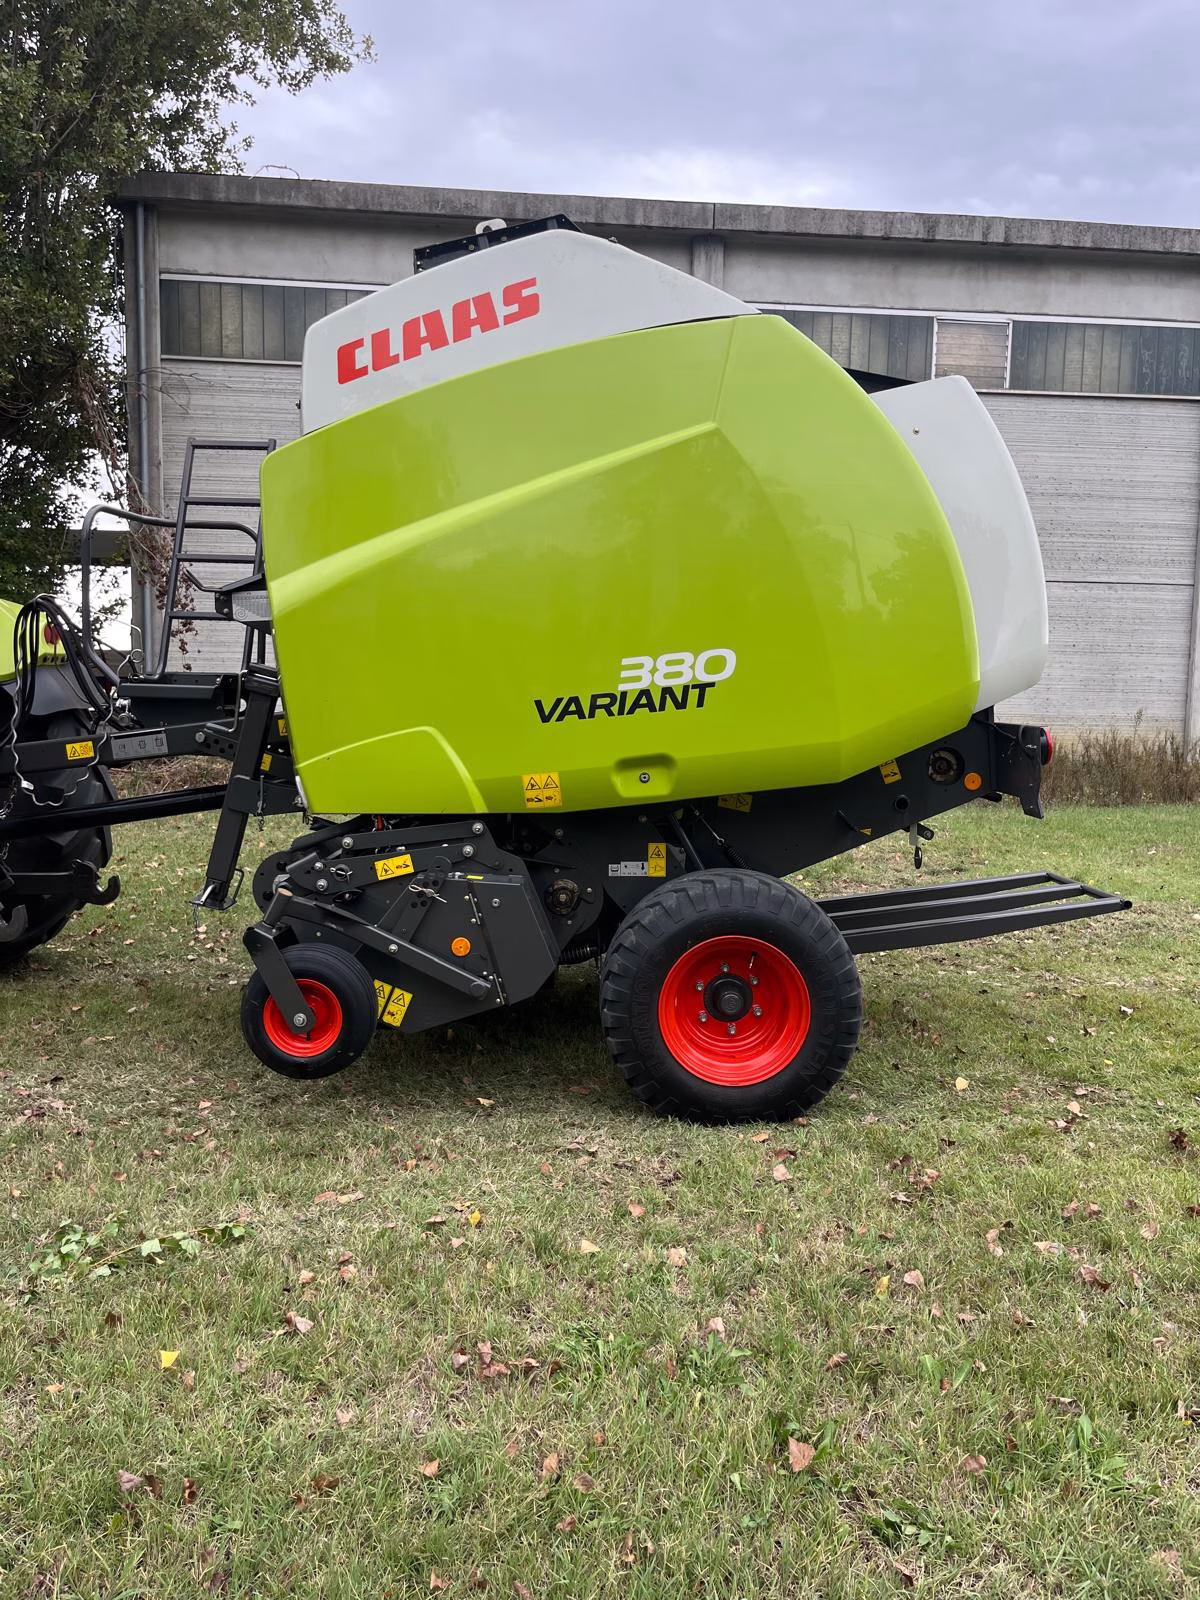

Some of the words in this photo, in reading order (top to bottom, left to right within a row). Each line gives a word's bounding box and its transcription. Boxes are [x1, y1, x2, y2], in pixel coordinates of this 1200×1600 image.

[337, 277, 540, 385] CLAAS
[617, 648, 737, 691] 380
[534, 682, 716, 724] VARIANT
